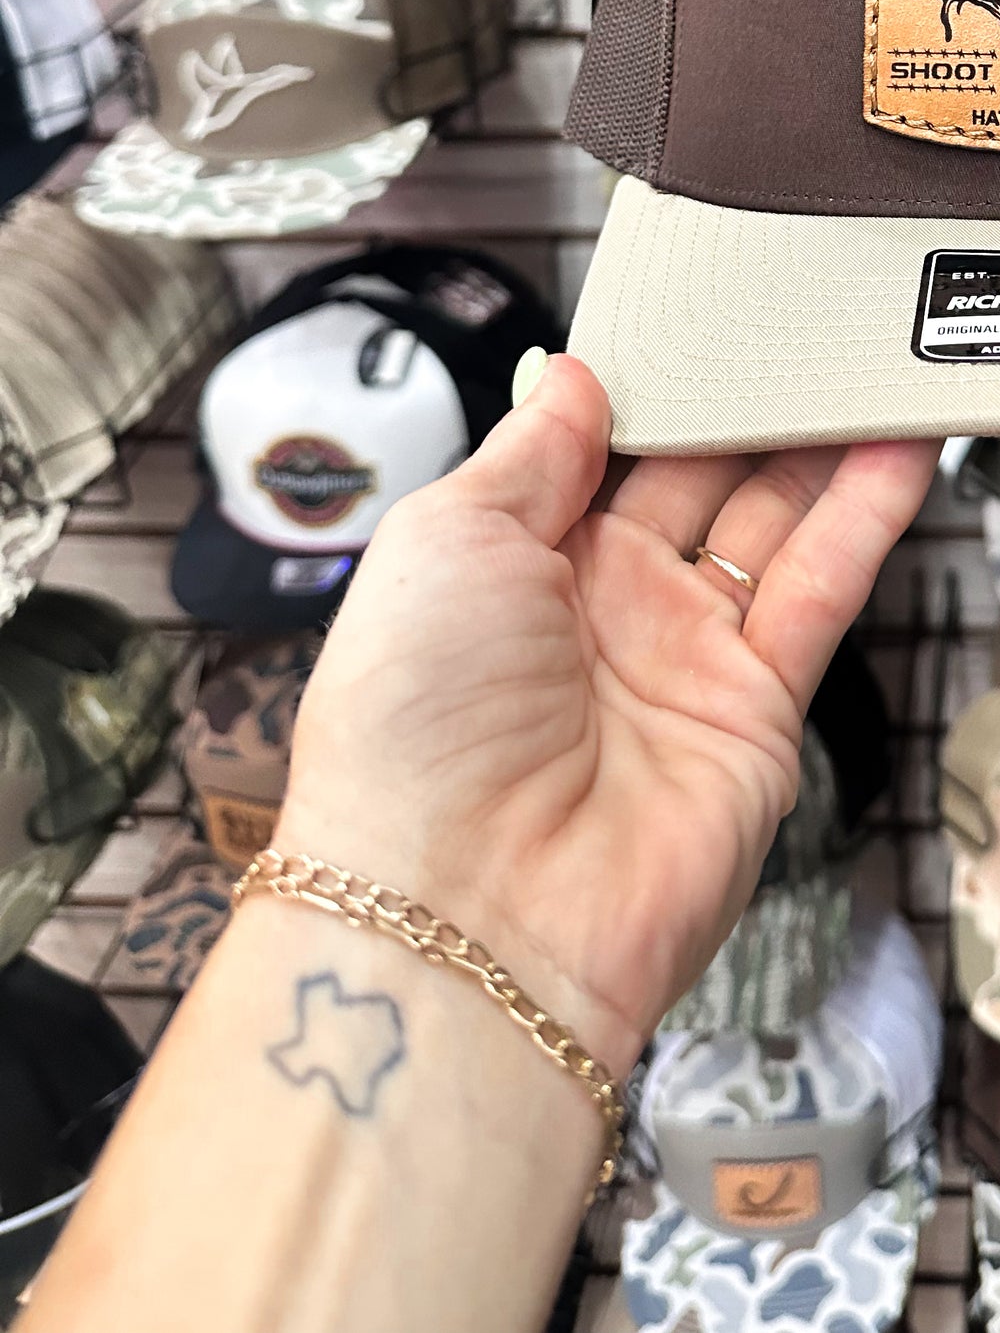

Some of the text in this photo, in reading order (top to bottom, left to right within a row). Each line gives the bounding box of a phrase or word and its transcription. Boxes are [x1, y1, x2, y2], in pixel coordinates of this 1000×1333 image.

[890, 62, 994, 81] SHOOT
[951, 271, 992, 280] EST.
[937, 323, 1000, 336] ORIGINAL
